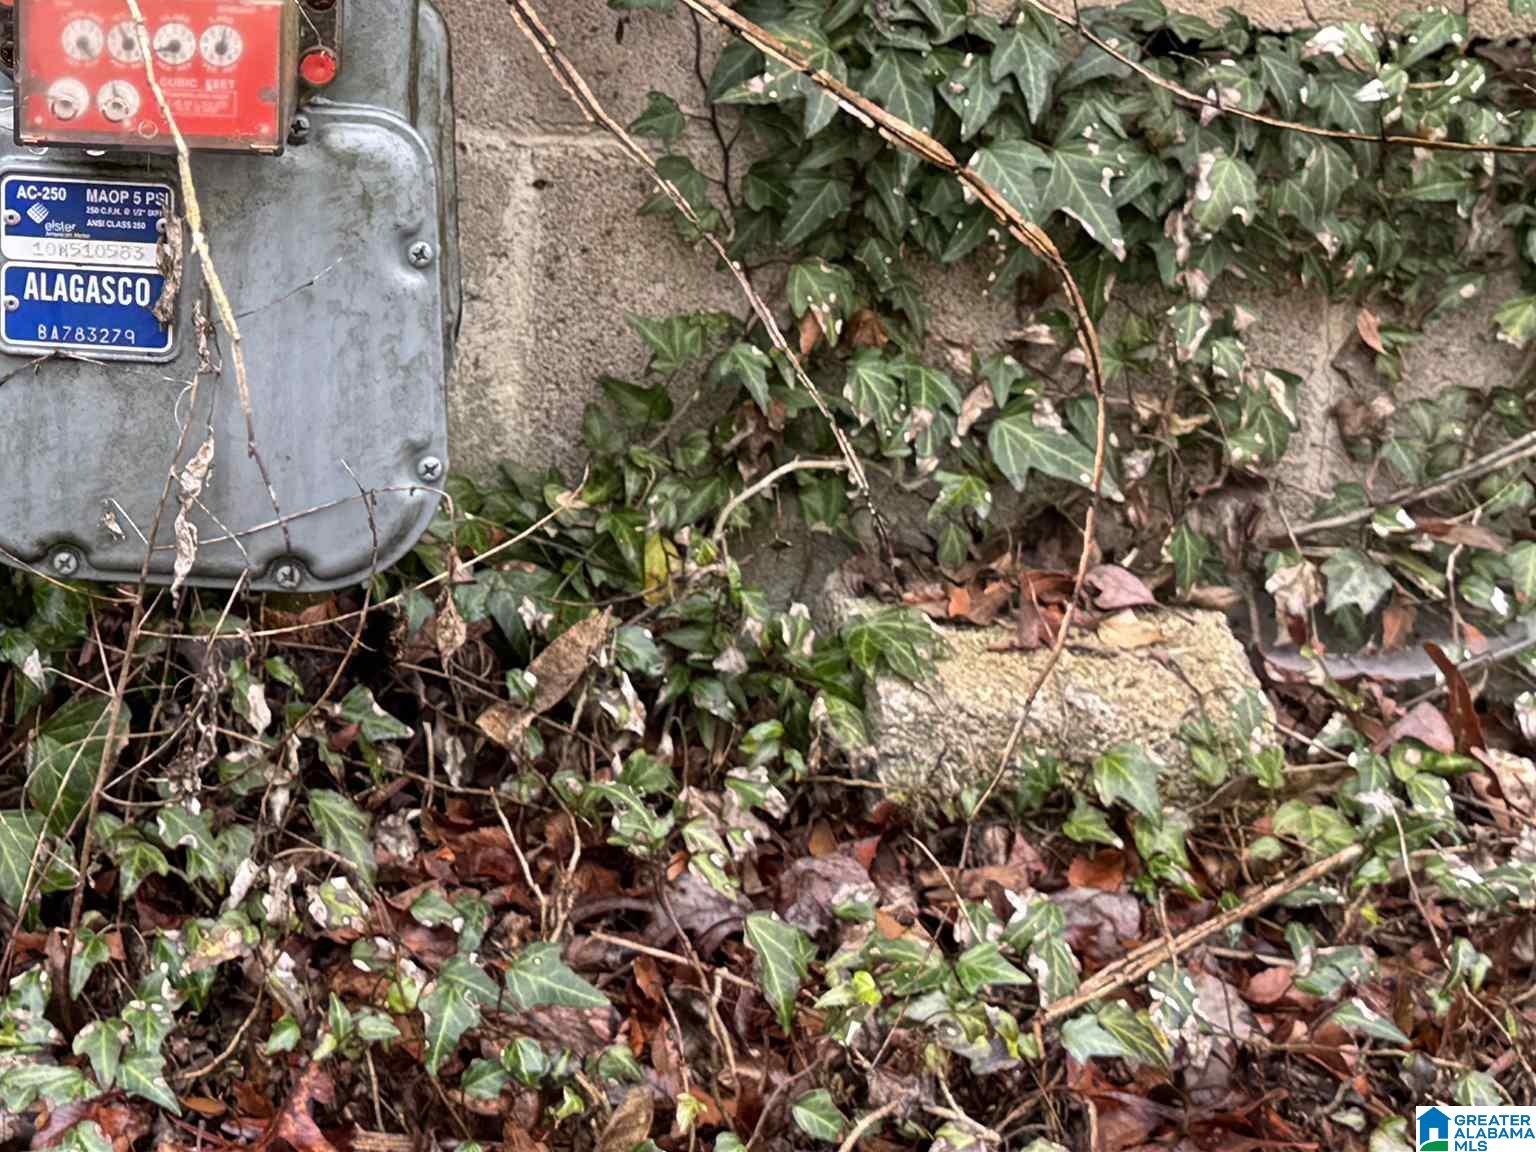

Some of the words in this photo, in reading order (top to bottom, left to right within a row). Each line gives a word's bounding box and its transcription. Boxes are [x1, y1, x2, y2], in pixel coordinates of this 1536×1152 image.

[16, 184, 67, 202] AC-250
[85, 188, 130, 205] MAOP
[133, 191, 142, 205] 5
[145, 191, 169, 206] PSI
[45, 219, 76, 233] elster
[86, 218, 105, 228] ANSI
[106, 220, 132, 229] CLASS
[23, 271, 151, 307] ALAGASCO
